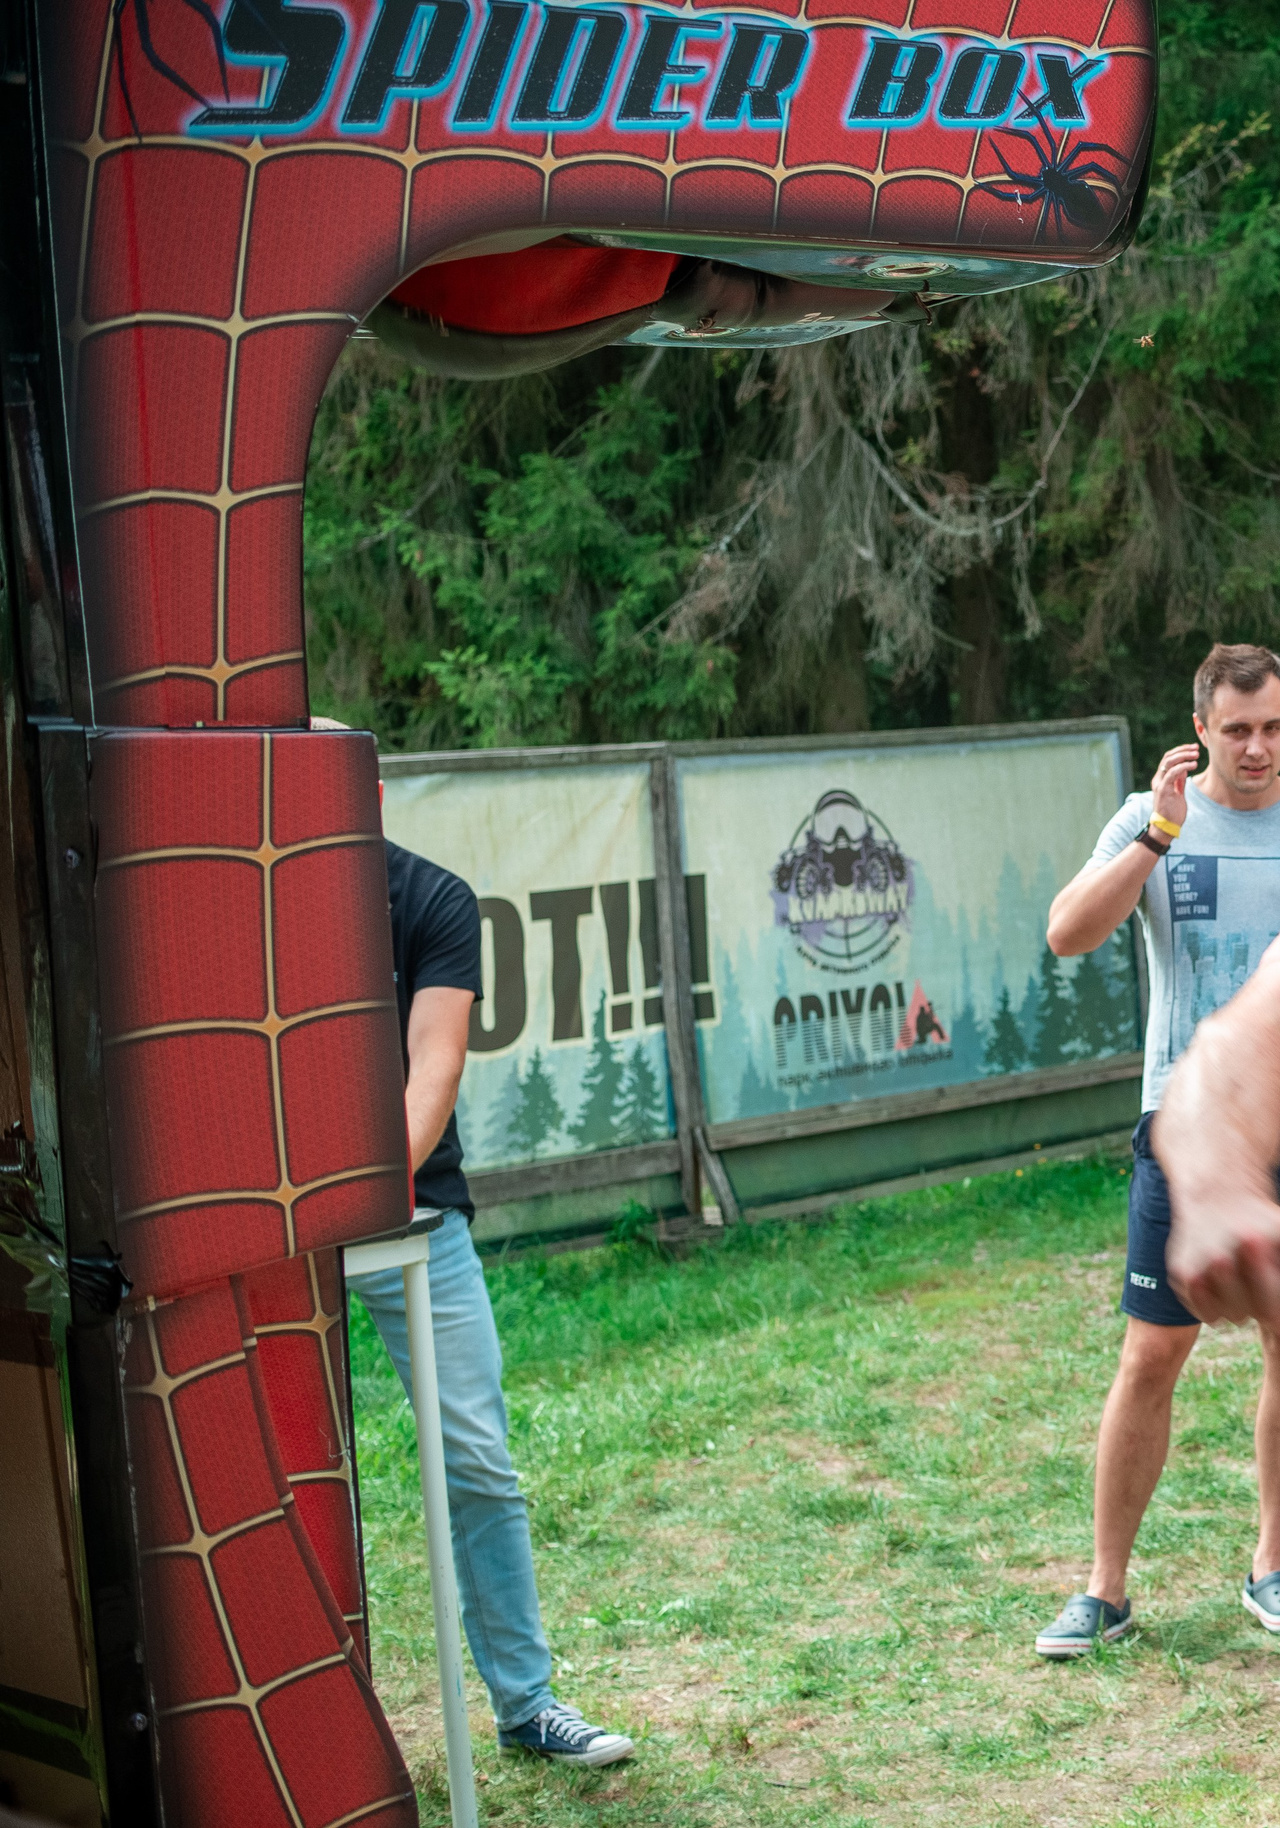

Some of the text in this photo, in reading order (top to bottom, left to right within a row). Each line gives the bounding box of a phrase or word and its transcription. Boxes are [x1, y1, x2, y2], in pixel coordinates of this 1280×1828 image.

[186, 0, 1106, 135] SPIDER BOX
[1177, 863, 1196, 873] HAVE
[1173, 873, 1188, 883] YOU
[1172, 882, 1191, 893] BEEN
[1173, 891, 1199, 903] THERE?
